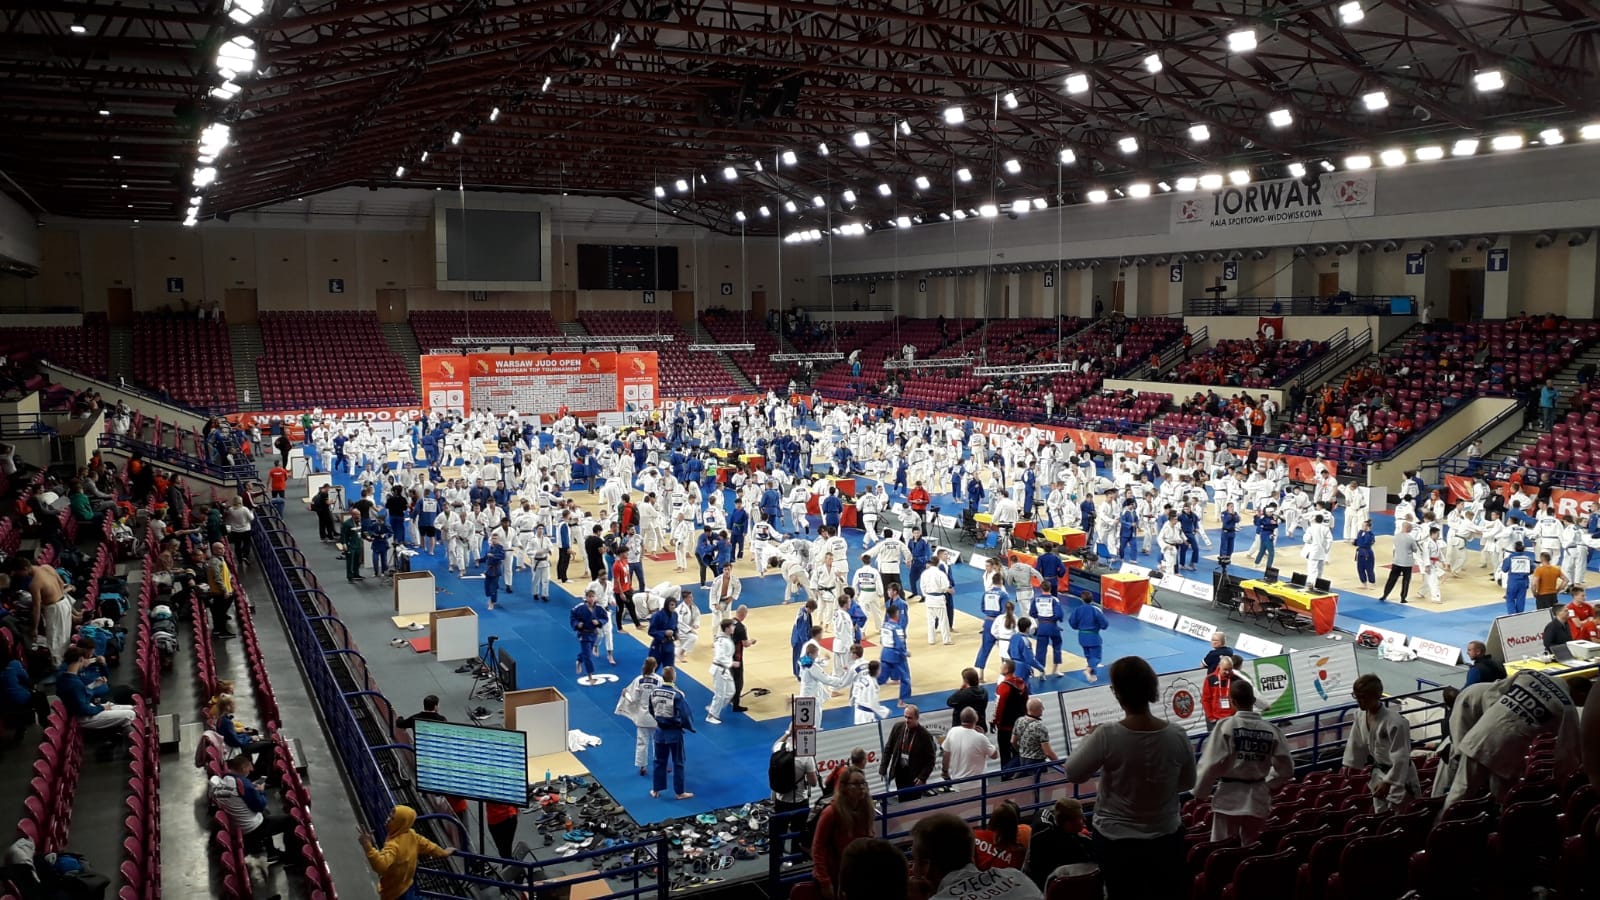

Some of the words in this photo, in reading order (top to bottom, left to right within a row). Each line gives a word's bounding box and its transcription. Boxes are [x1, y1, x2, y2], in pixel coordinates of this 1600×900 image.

[1211, 180, 1321, 216] TORWAR
[1210, 218, 1227, 228] HALA
[1491, 253, 1504, 270] T
[1045, 275, 1052, 286] R
[1172, 268, 1181, 281] S
[171, 280, 181, 291] L
[645, 293, 653, 303] N
[495, 360, 533, 368] WARSAW
[535, 359, 557, 367] JUDO
[559, 359, 581, 367] OPEN
[1188, 626, 1206, 638] HILL
[1190, 621, 1211, 634] GREEN
[1507, 631, 1546, 648] Mazowsz
[1419, 641, 1449, 656] IPPON
[1261, 673, 1287, 685] GREEN
[1262, 681, 1285, 692] HILL
[1507, 687, 1547, 719] JUDO
[800, 708, 810, 722] 3
[975, 838, 1013, 864] POLSKA
[949, 869, 1002, 897] CZECH
